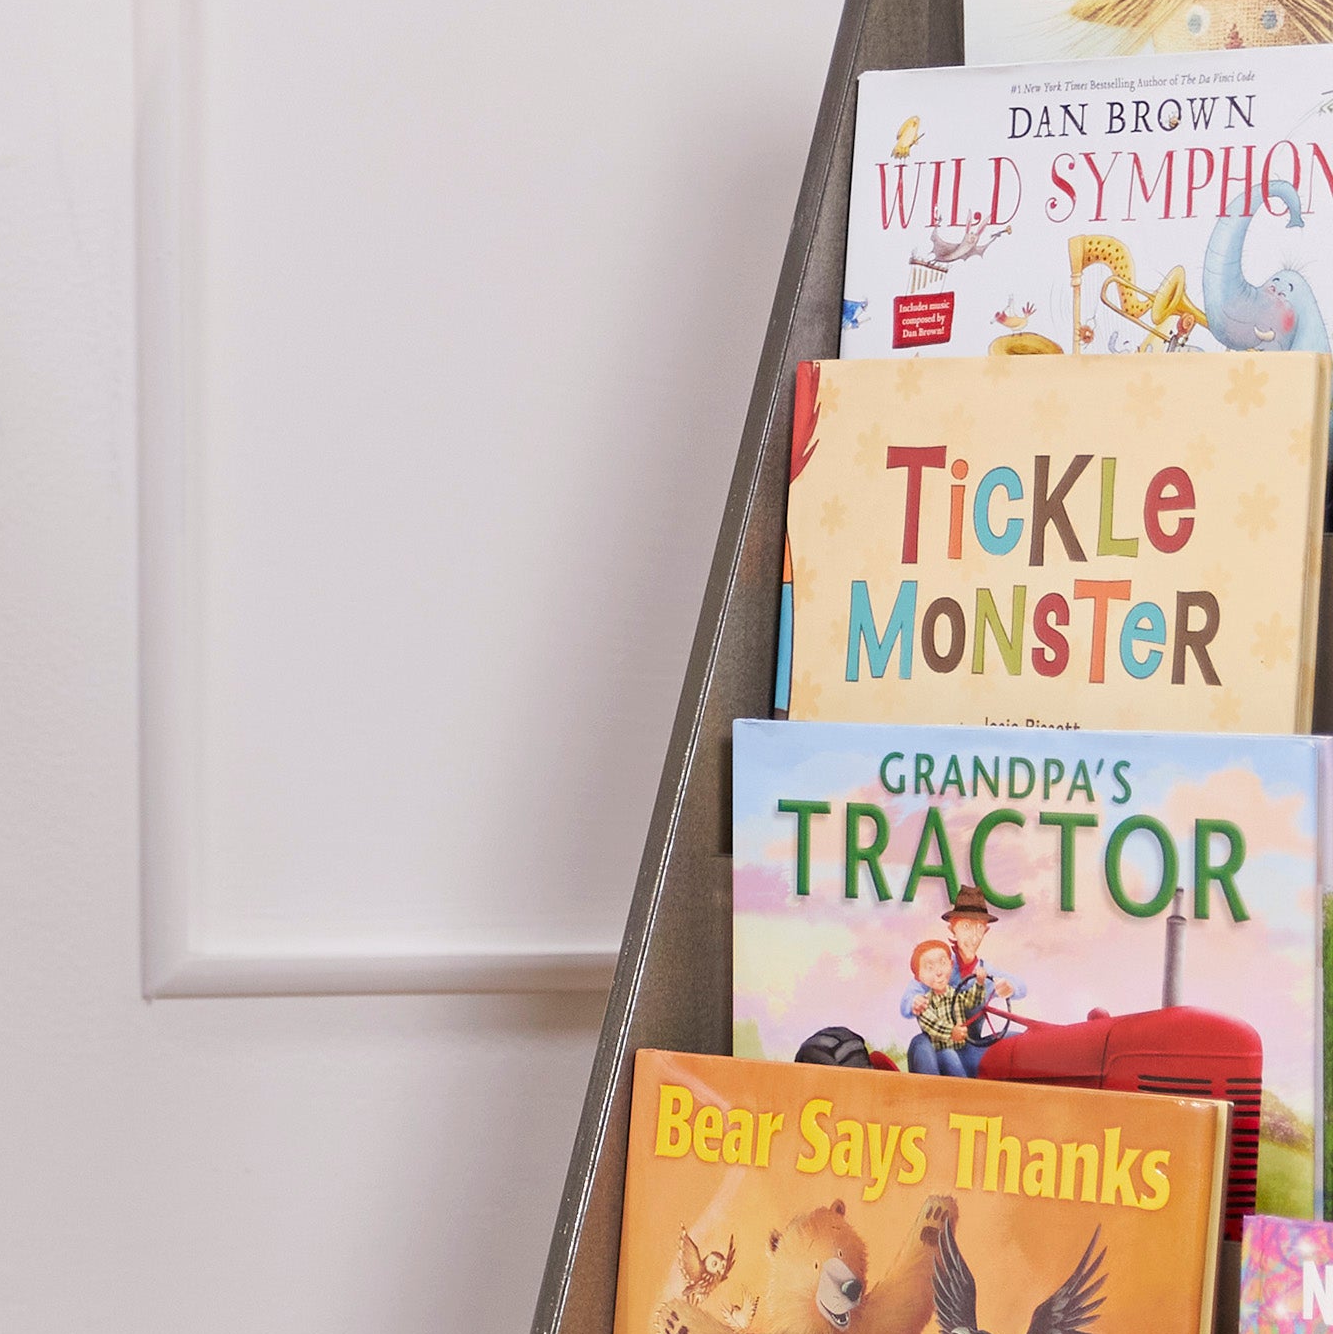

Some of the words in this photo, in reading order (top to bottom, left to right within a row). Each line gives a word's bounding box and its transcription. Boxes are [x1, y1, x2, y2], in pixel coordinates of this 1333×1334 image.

[1023, 83, 1041, 94] New
[1044, 81, 1062, 92] York
[1065, 80, 1088, 91] Times
[1090, 78, 1135, 92] Bestselling
[1138, 76, 1167, 88] Author
[1169, 75, 1179, 86] of
[1181, 74, 1197, 85] The
[1198, 74, 1211, 84] Da
[1213, 72, 1234, 83] Vinci
[1236, 71, 1256, 82] Code
[1007, 103, 1088, 139] DAN
[1105, 95, 1256, 134] BROWN
[875, 156, 1022, 231] WILD
[899, 302, 928, 313] Includes
[929, 300, 950, 310] music
[901, 314, 936, 327] composed
[937, 313, 946, 325] by
[902, 329, 917, 338] Dan
[918, 327, 945, 336] Brown!
[879, 751, 1132, 805] GRANDPA'S
[777, 798, 1251, 924] TRACTOR
[654, 1085, 784, 1169] Bear
[796, 1098, 927, 1203] Says
[949, 1113, 1172, 1212] Thanks
